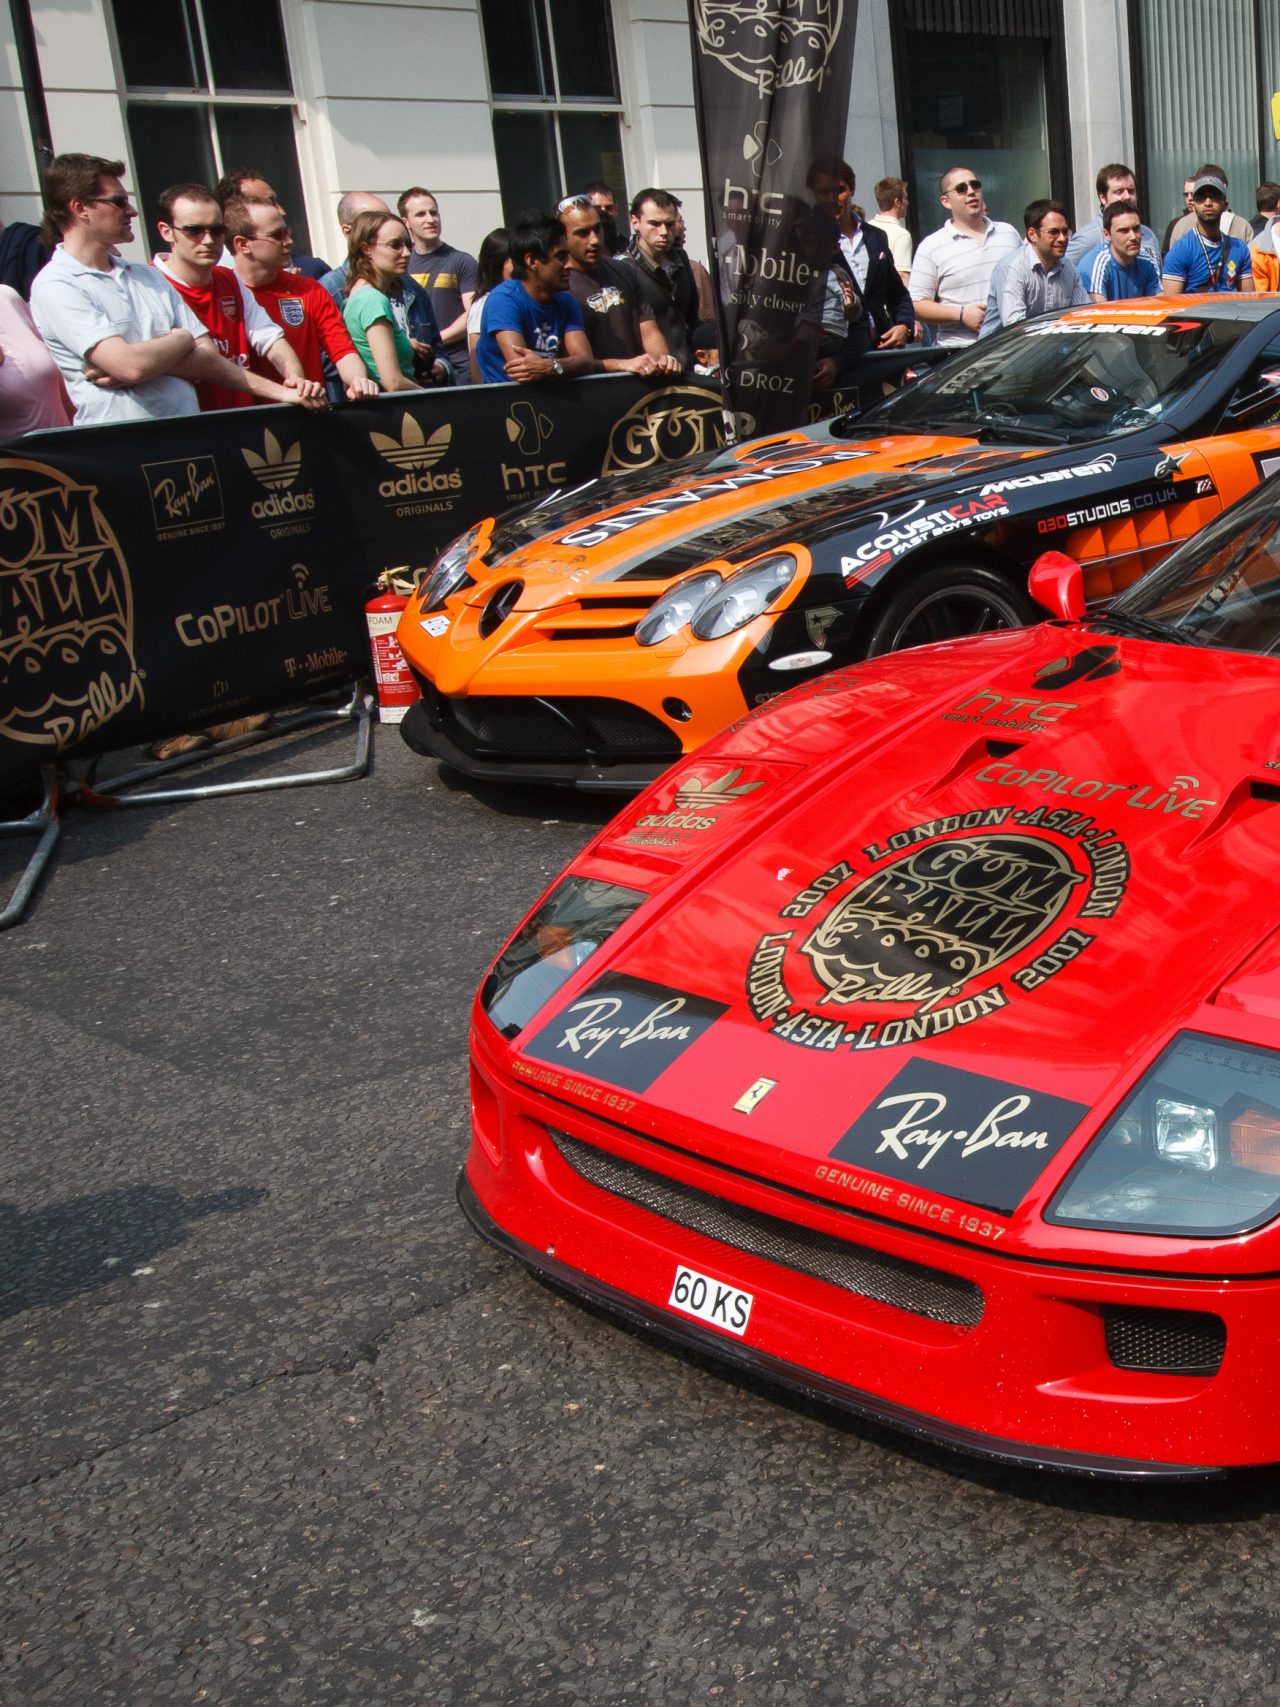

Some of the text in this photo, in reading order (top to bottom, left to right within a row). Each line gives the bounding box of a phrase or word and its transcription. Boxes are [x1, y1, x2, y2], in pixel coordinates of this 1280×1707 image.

[763, 292, 806, 314] closer
[740, 371, 795, 394] DROZ
[378, 470, 463, 499] adidas
[979, 461, 1115, 497] McLaren
[252, 491, 316, 520] adidas
[396, 500, 454, 518] ORIGINALS
[270, 522, 311, 541] ORIGINALS
[892, 532, 930, 556] FAST
[973, 506, 1010, 522] TOYS
[368, 616, 393, 625] FOAM
[635, 810, 718, 831] adidas
[781, 806, 1131, 992] 2007 LONDON ASIA LONDON 2007
[746, 930, 1009, 1051] LONDON ASIA LONDON
[821, 971, 952, 1013] Rally
[511, 1060, 637, 1113] GENUINE SINCE 1937
[875, 1091, 1049, 1170] Ray-Ban
[815, 1165, 1007, 1241] GENUINE SINCE 1937
[674, 1271, 749, 1328] 60 KS
